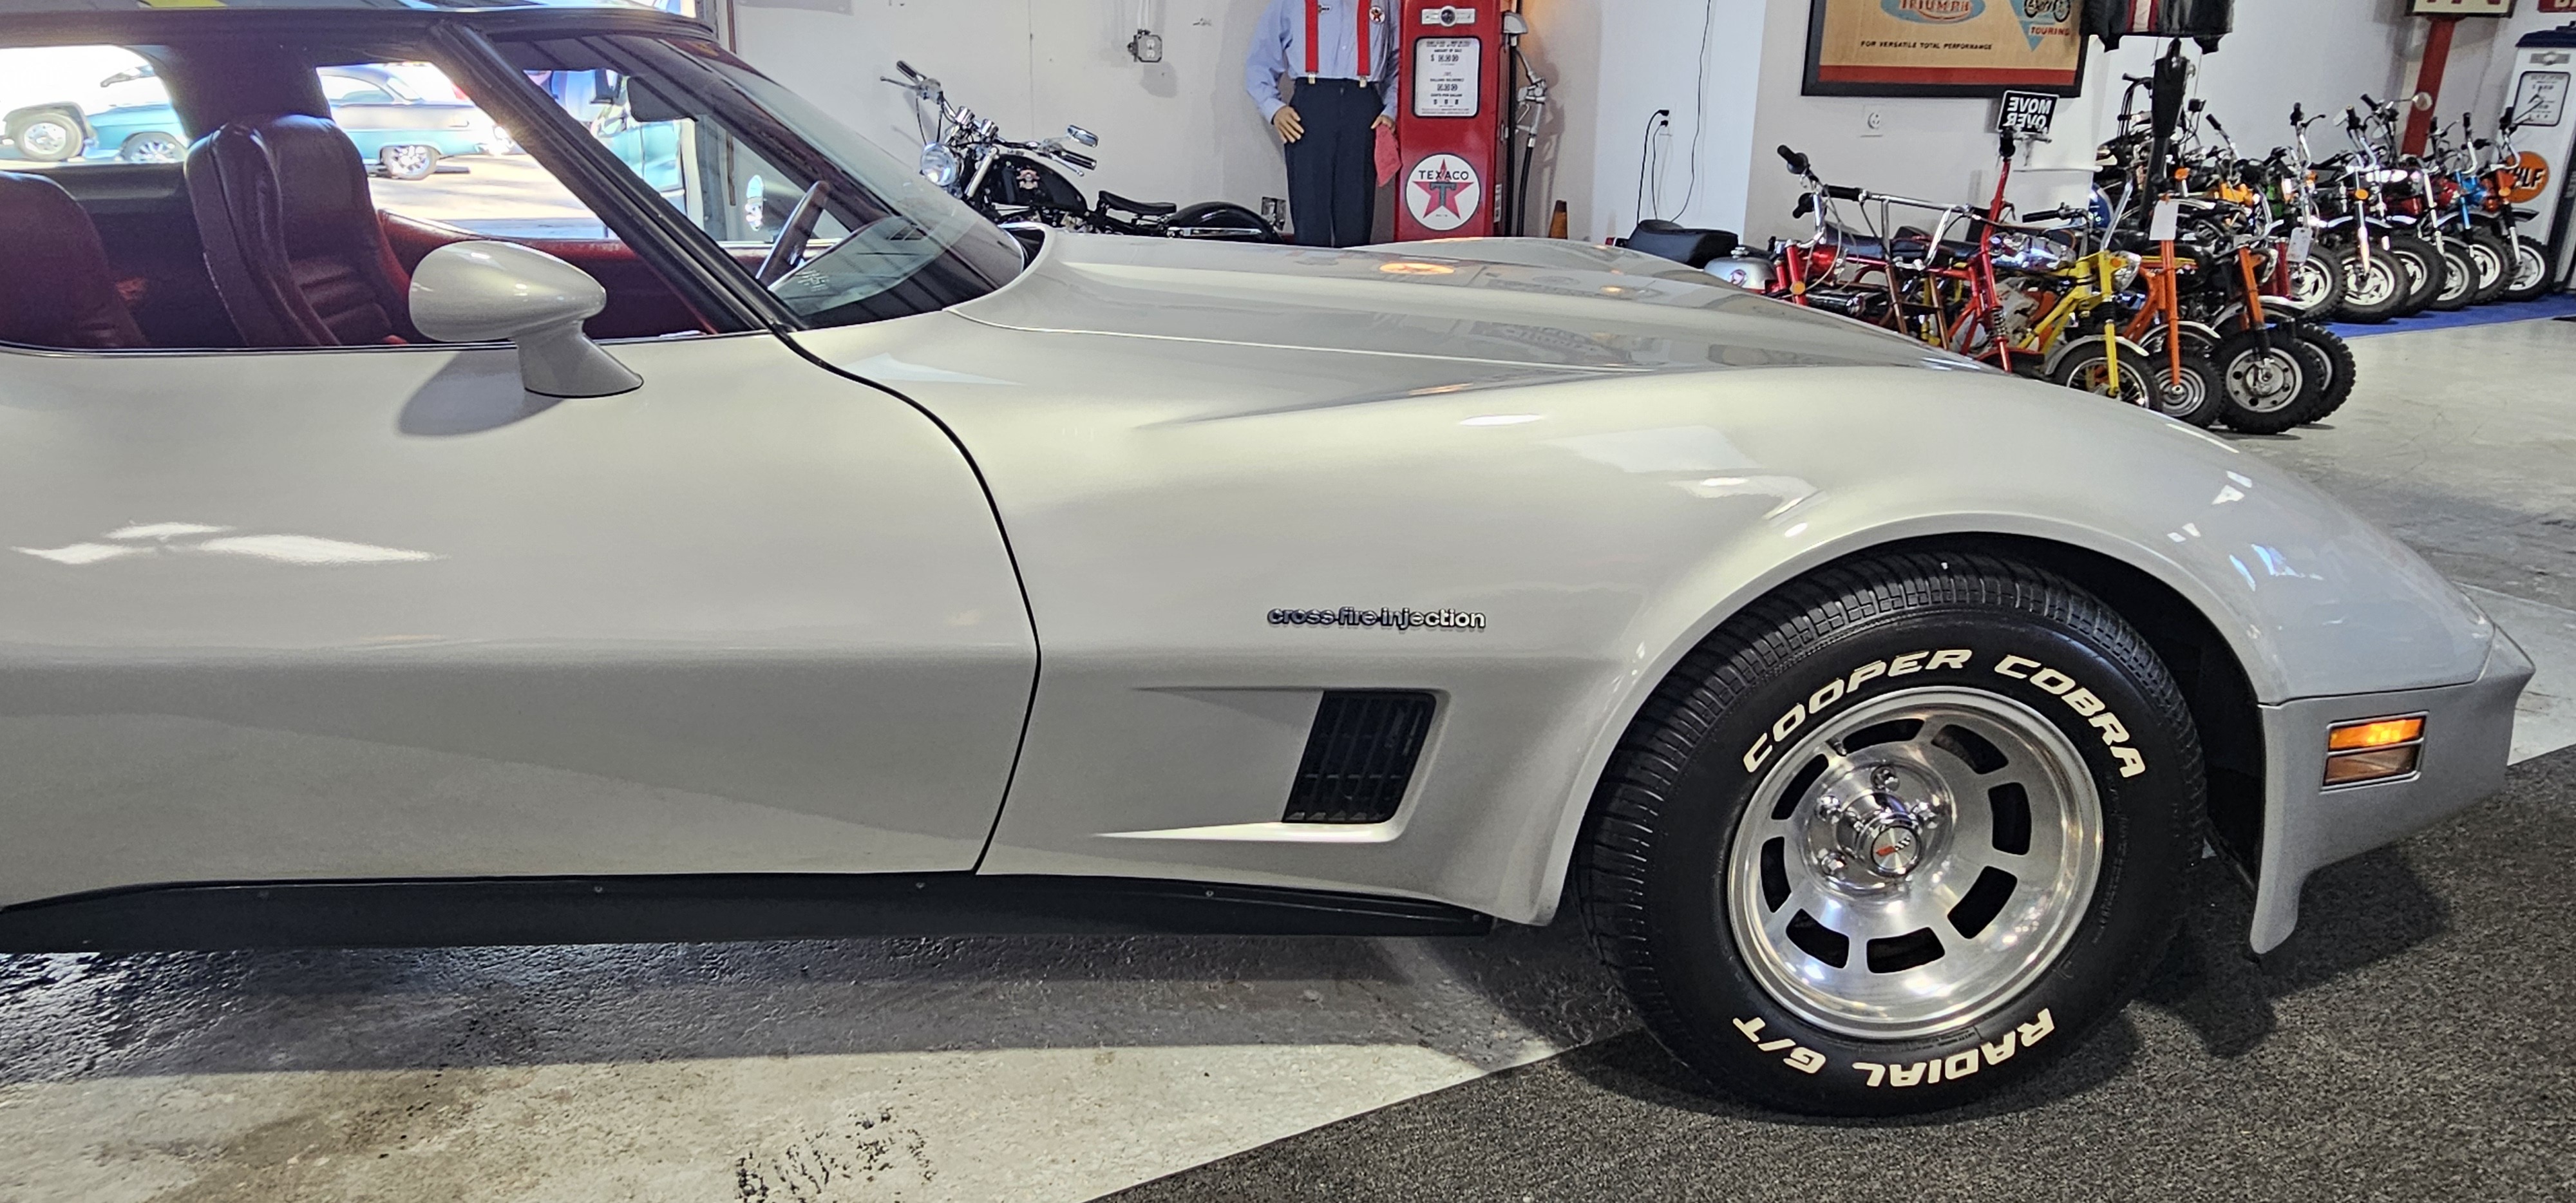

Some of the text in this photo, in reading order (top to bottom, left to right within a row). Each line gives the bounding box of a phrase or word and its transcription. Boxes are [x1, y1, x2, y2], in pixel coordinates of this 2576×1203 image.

[1419, 170, 1469, 180] TEXACO
[1743, 649, 2146, 778] COOPER COBRA
[1732, 1008, 2056, 1088] RADIAL G/T
